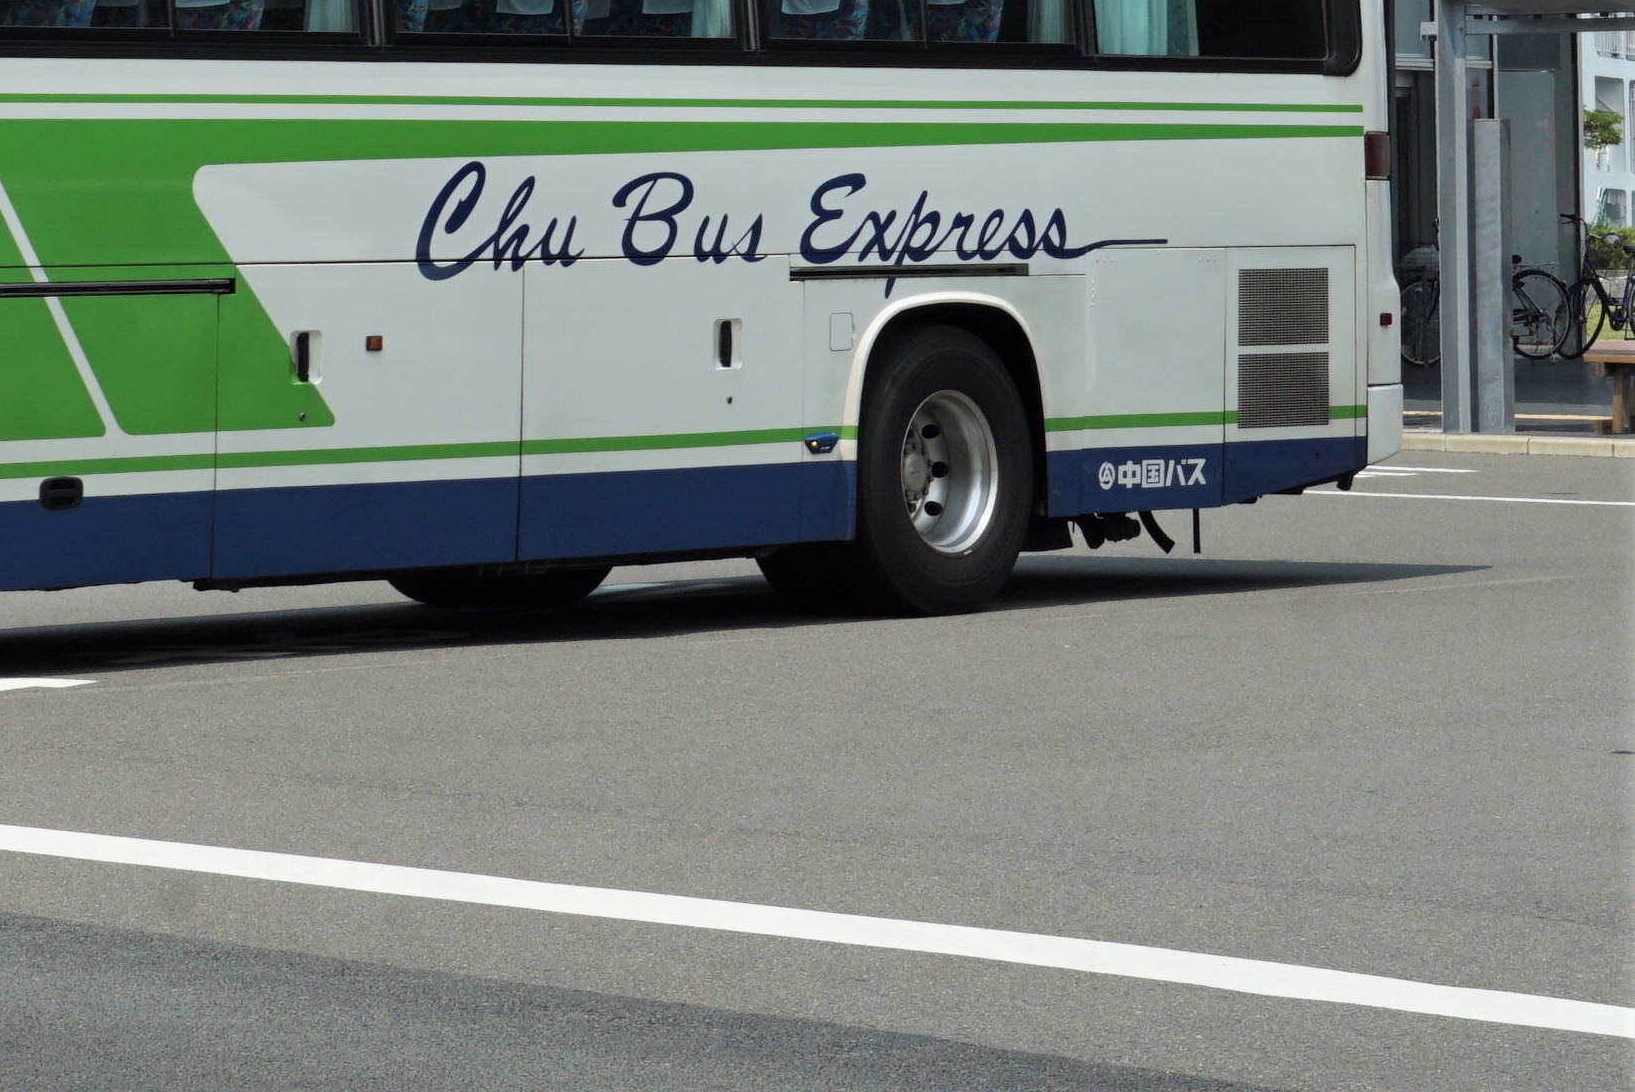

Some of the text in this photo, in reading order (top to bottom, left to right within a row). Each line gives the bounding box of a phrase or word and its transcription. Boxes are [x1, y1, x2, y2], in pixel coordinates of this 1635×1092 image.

[415, 160, 1168, 299] Chu Bus Express
[1117, 458, 1208, 489] 中国バス
